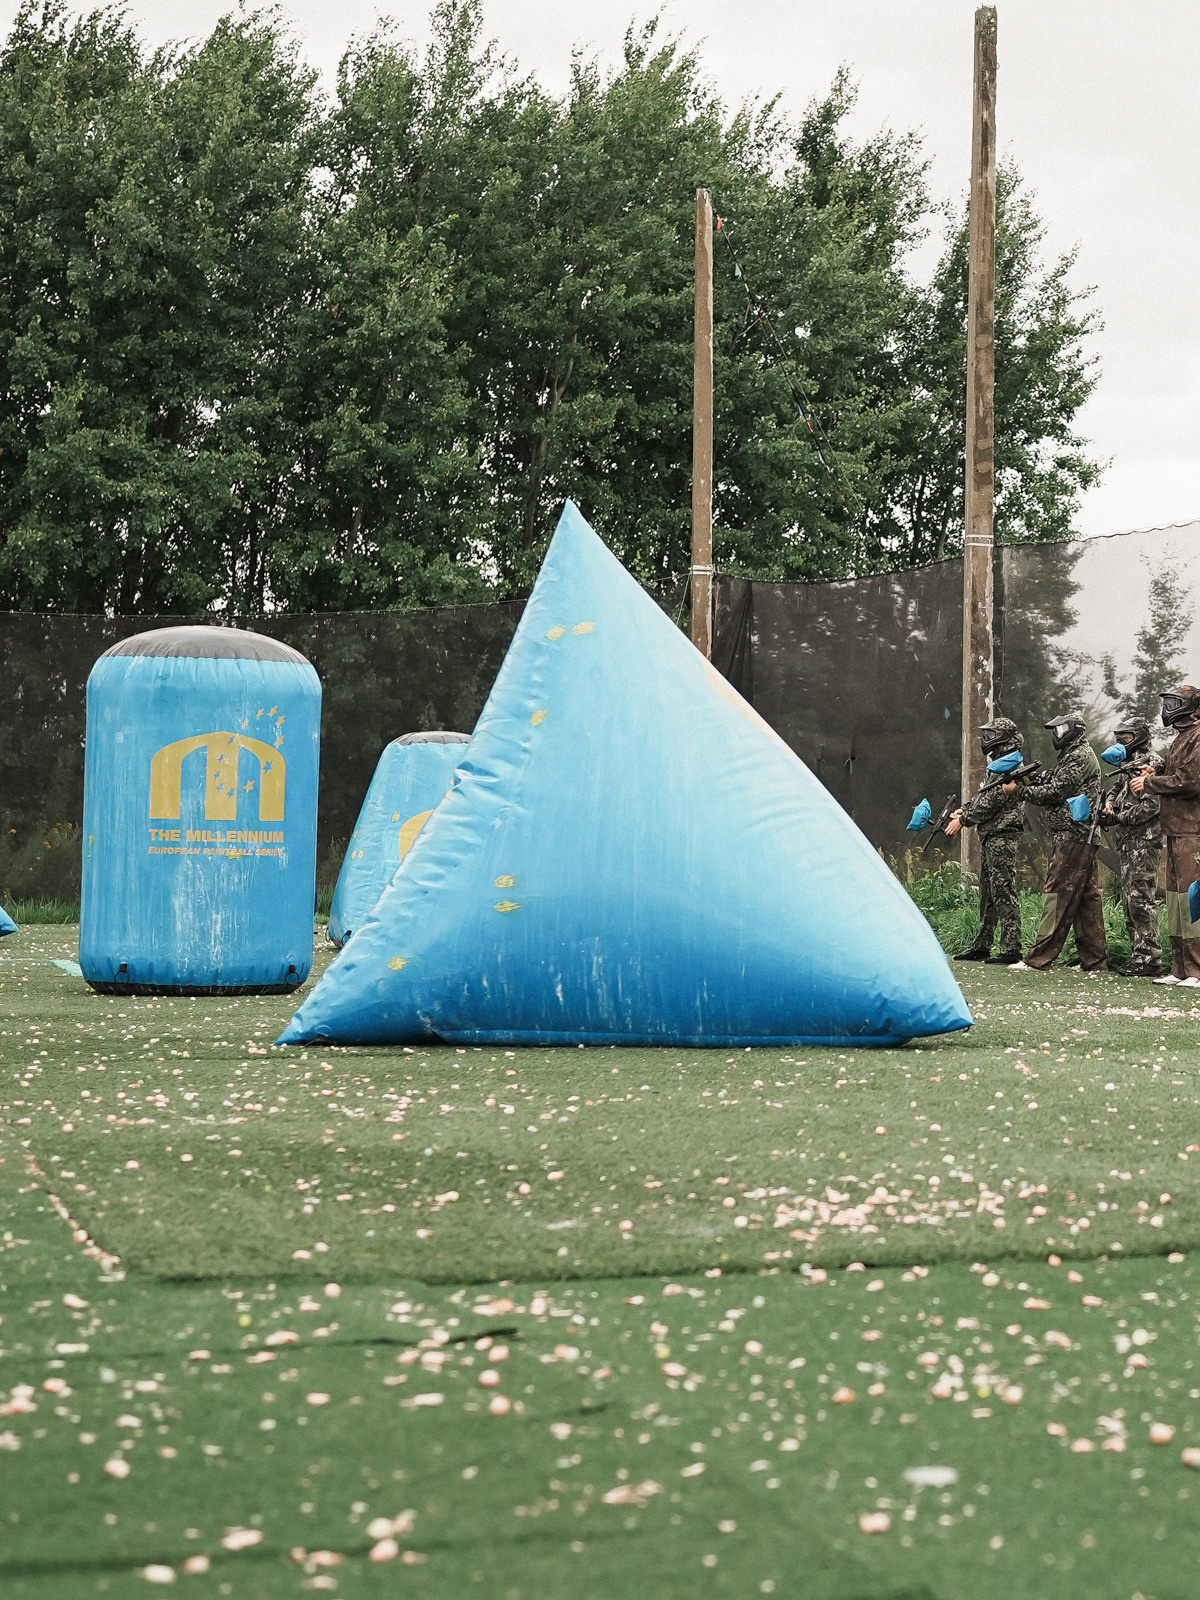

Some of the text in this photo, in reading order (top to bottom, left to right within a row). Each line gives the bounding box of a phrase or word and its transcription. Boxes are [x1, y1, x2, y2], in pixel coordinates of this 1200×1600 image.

[149, 829, 285, 843] THE MILLENNIUM
[148, 847, 201, 855] EUROPEAN
